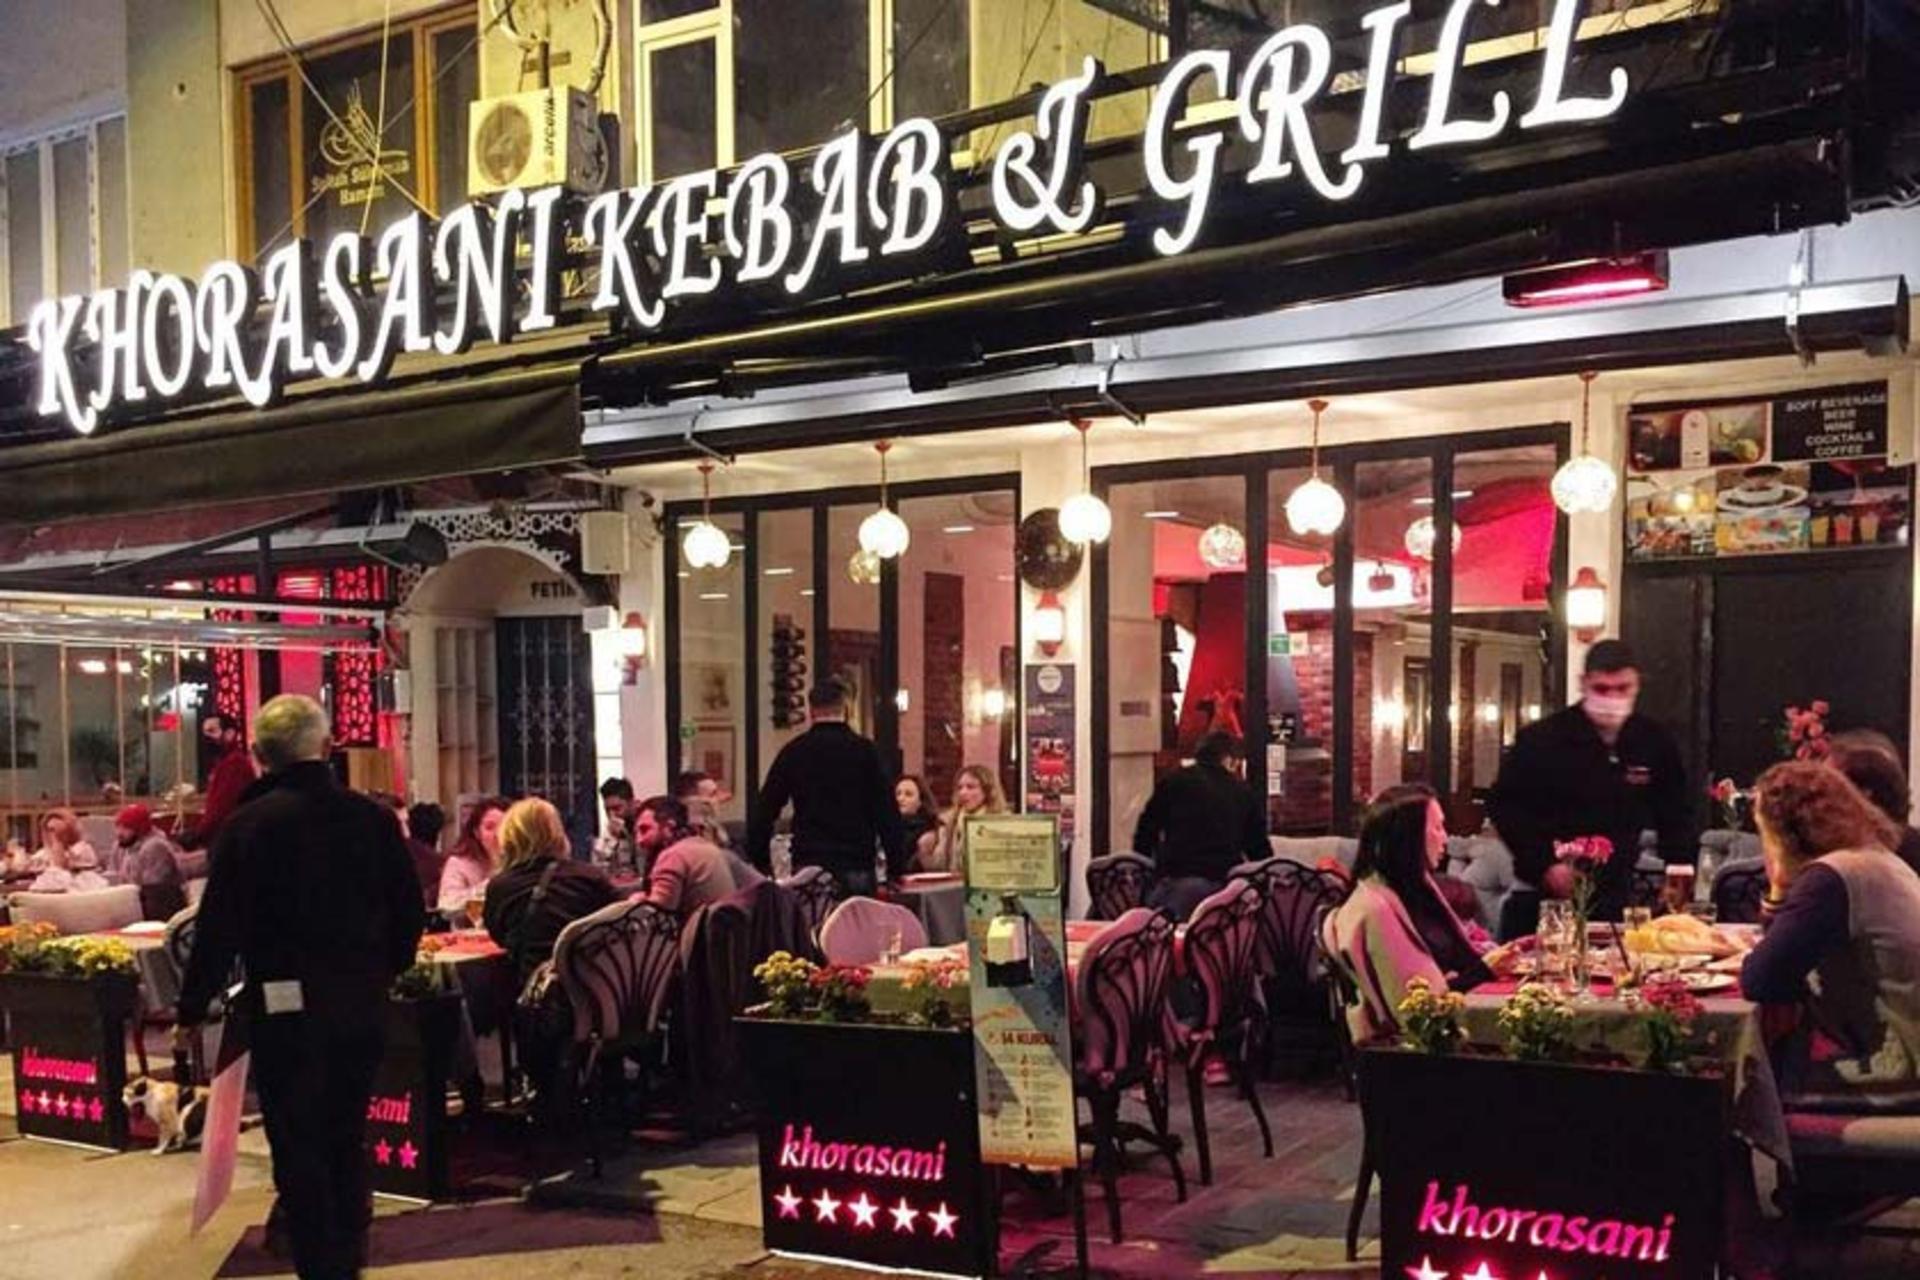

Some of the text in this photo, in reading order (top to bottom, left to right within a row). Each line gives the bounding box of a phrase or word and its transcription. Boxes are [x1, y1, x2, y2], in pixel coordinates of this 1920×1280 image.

[27, 0, 1628, 434] KHORASANI KEBAB & GRILL
[1785, 400, 1819, 412] SOFT
[1823, 408, 1857, 421] BEER
[1823, 420, 1855, 432] WINE
[1804, 430, 1875, 446] COCKTAILS
[1813, 444, 1863, 457] COFFEE
[780, 1123, 946, 1181] khorasani
[1417, 1178, 1676, 1262] khorasani
